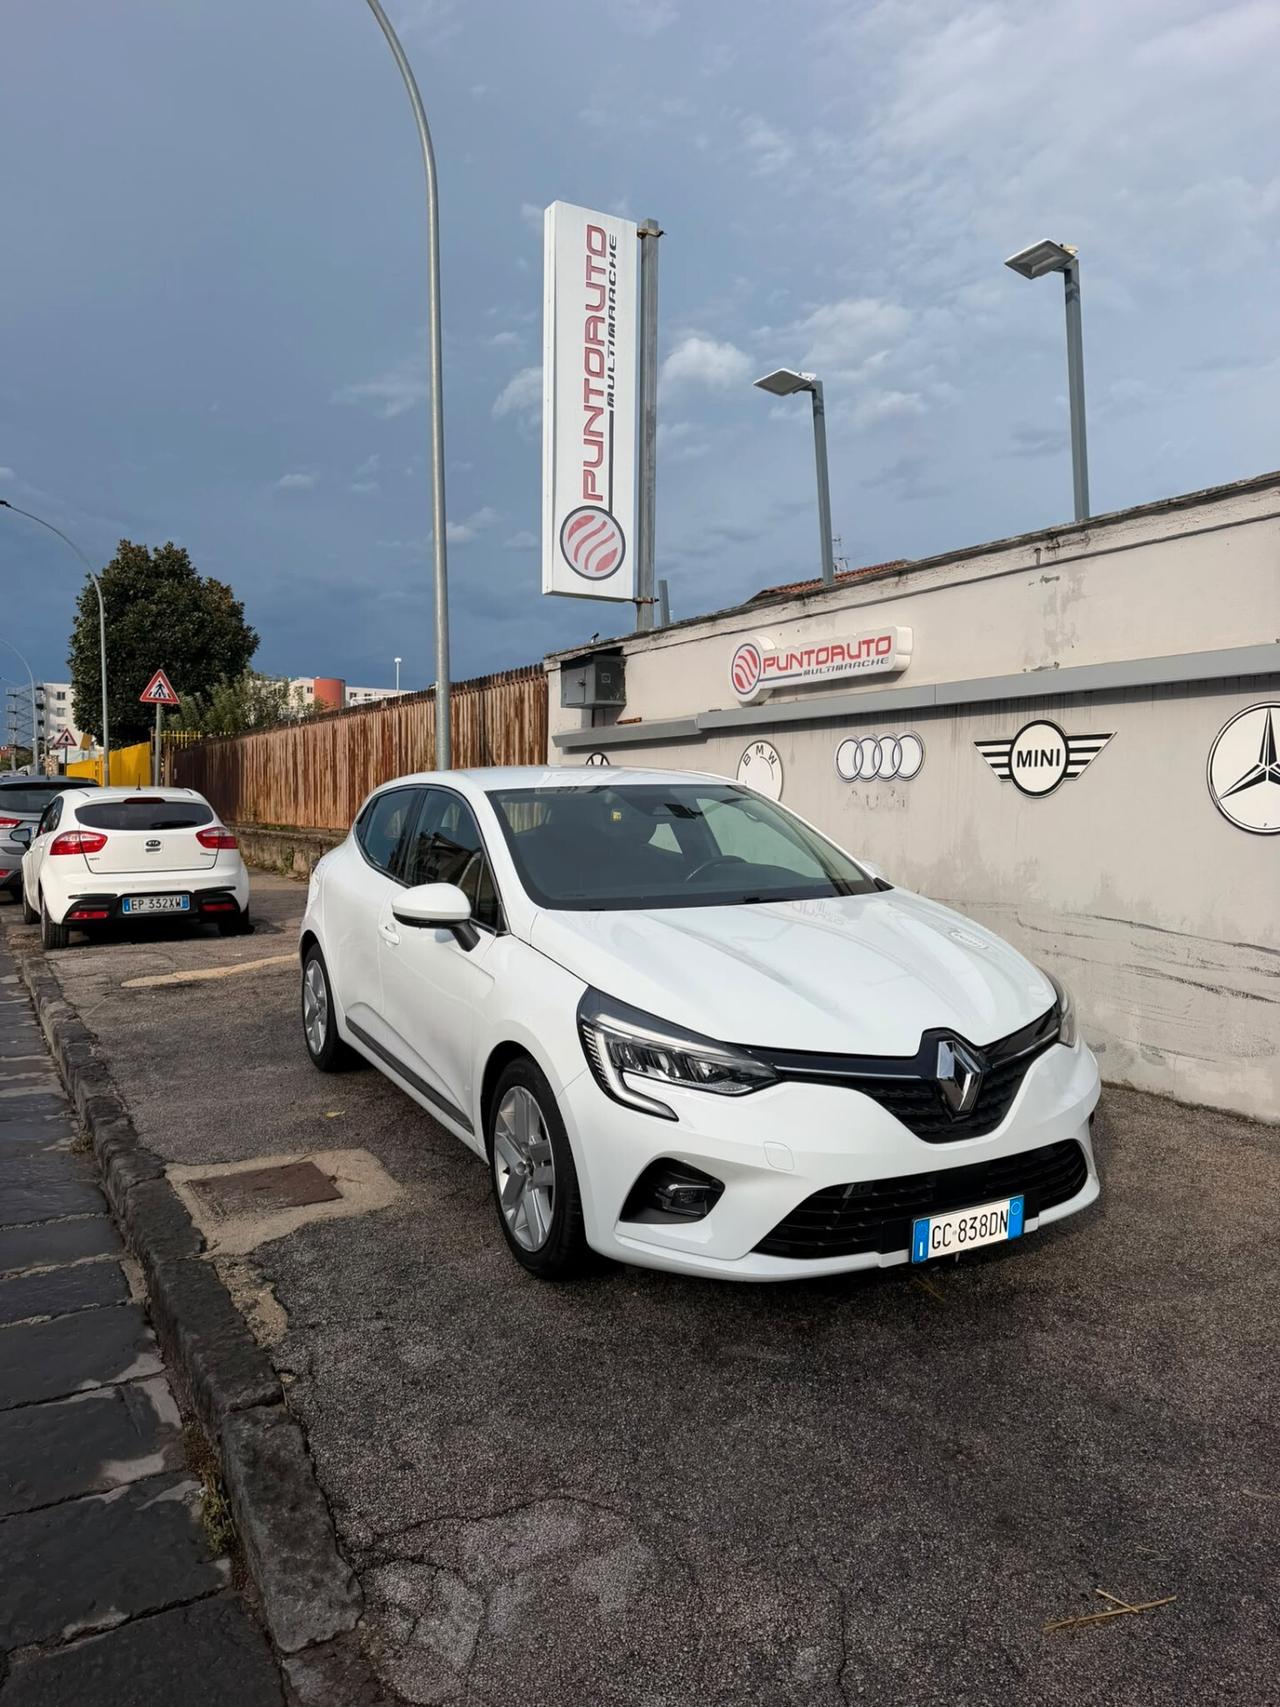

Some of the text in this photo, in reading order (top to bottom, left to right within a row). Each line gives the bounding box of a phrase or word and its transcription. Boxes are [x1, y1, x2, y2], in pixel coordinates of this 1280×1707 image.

[606, 233, 618, 409] MULTIMARCHE
[583, 224, 607, 502] PUNTOAUTO
[762, 635, 891, 674] PUNTOAUTO
[803, 656, 889, 676] MULTIMARCHE
[743, 745, 778, 767] BMW
[1016, 748, 1061, 768] MINI
[131, 899, 144, 911] EP
[148, 896, 181, 909] 332XW
[931, 1222, 953, 1250] GC
[957, 1208, 1009, 1243] 838DN
